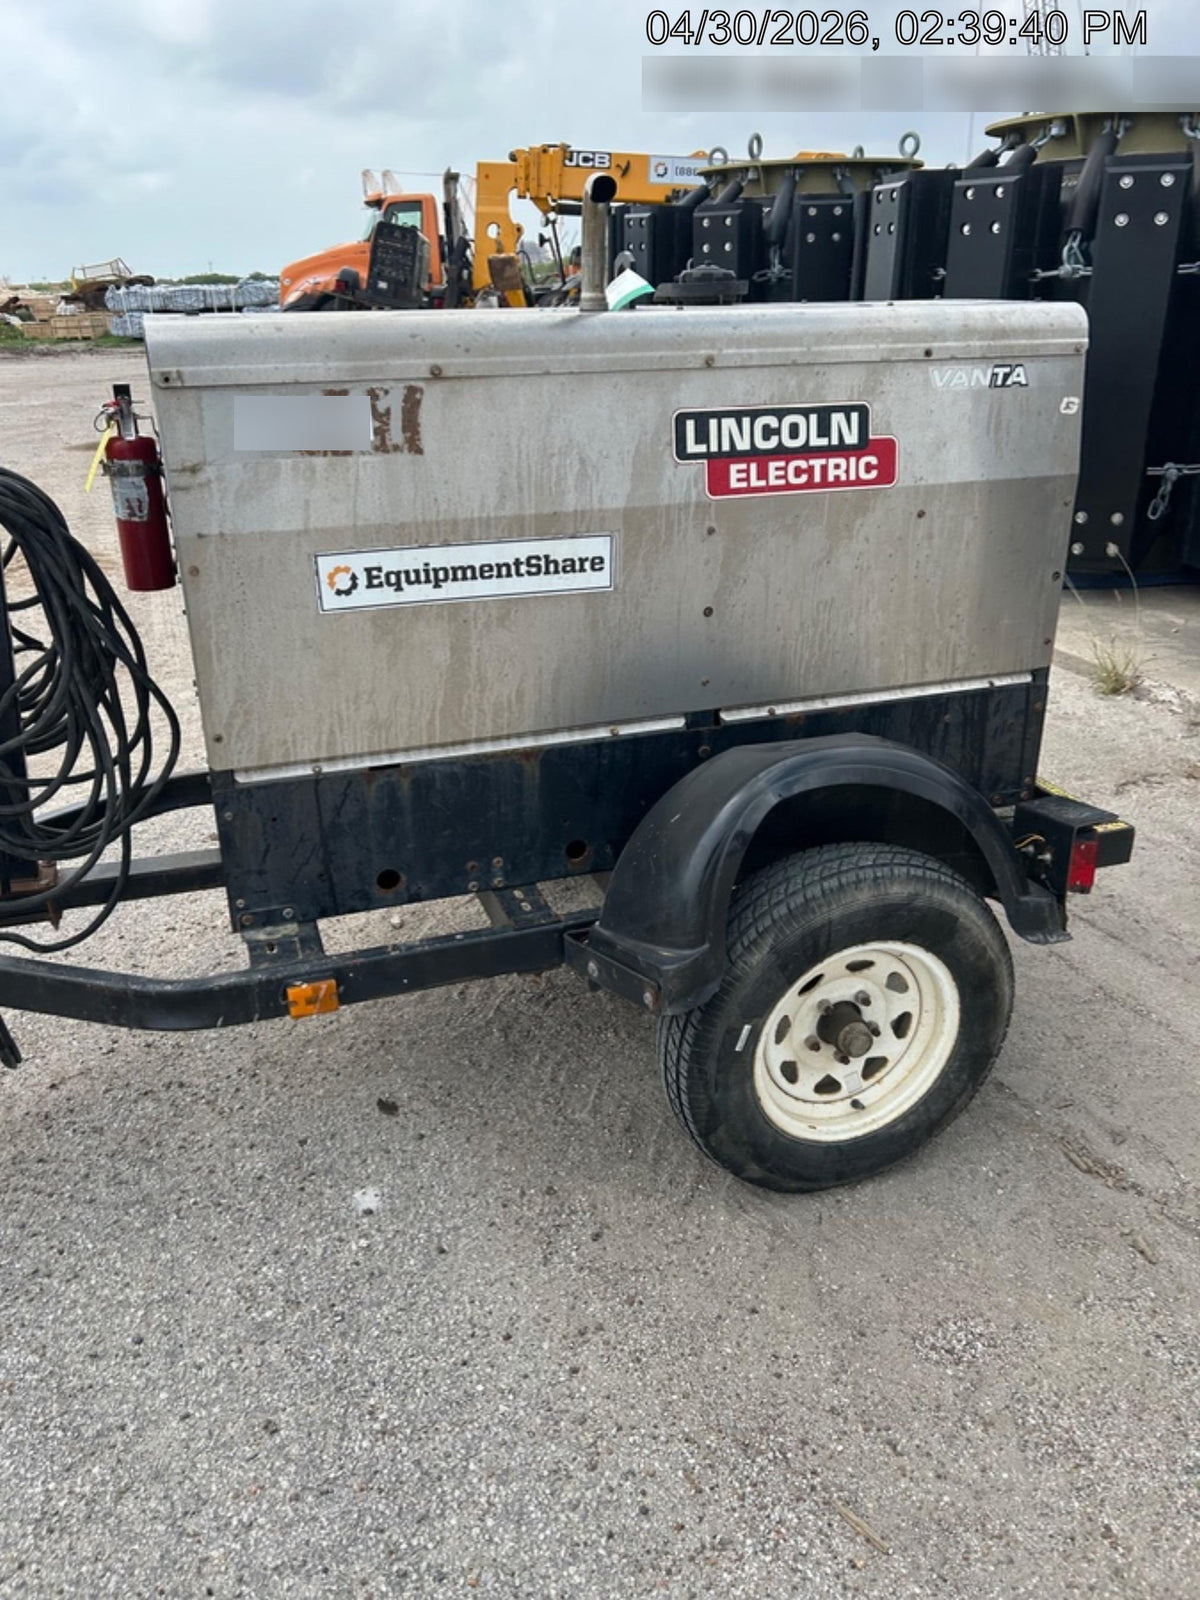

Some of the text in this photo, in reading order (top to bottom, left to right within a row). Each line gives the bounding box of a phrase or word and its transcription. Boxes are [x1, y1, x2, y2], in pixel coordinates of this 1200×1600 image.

[564, 152, 610, 167] JCB
[930, 365, 1028, 388] VANTA
[685, 411, 859, 454] LINCOLN
[729, 455, 879, 489] ELECTRIC
[364, 554, 605, 592] EquipmentShare
